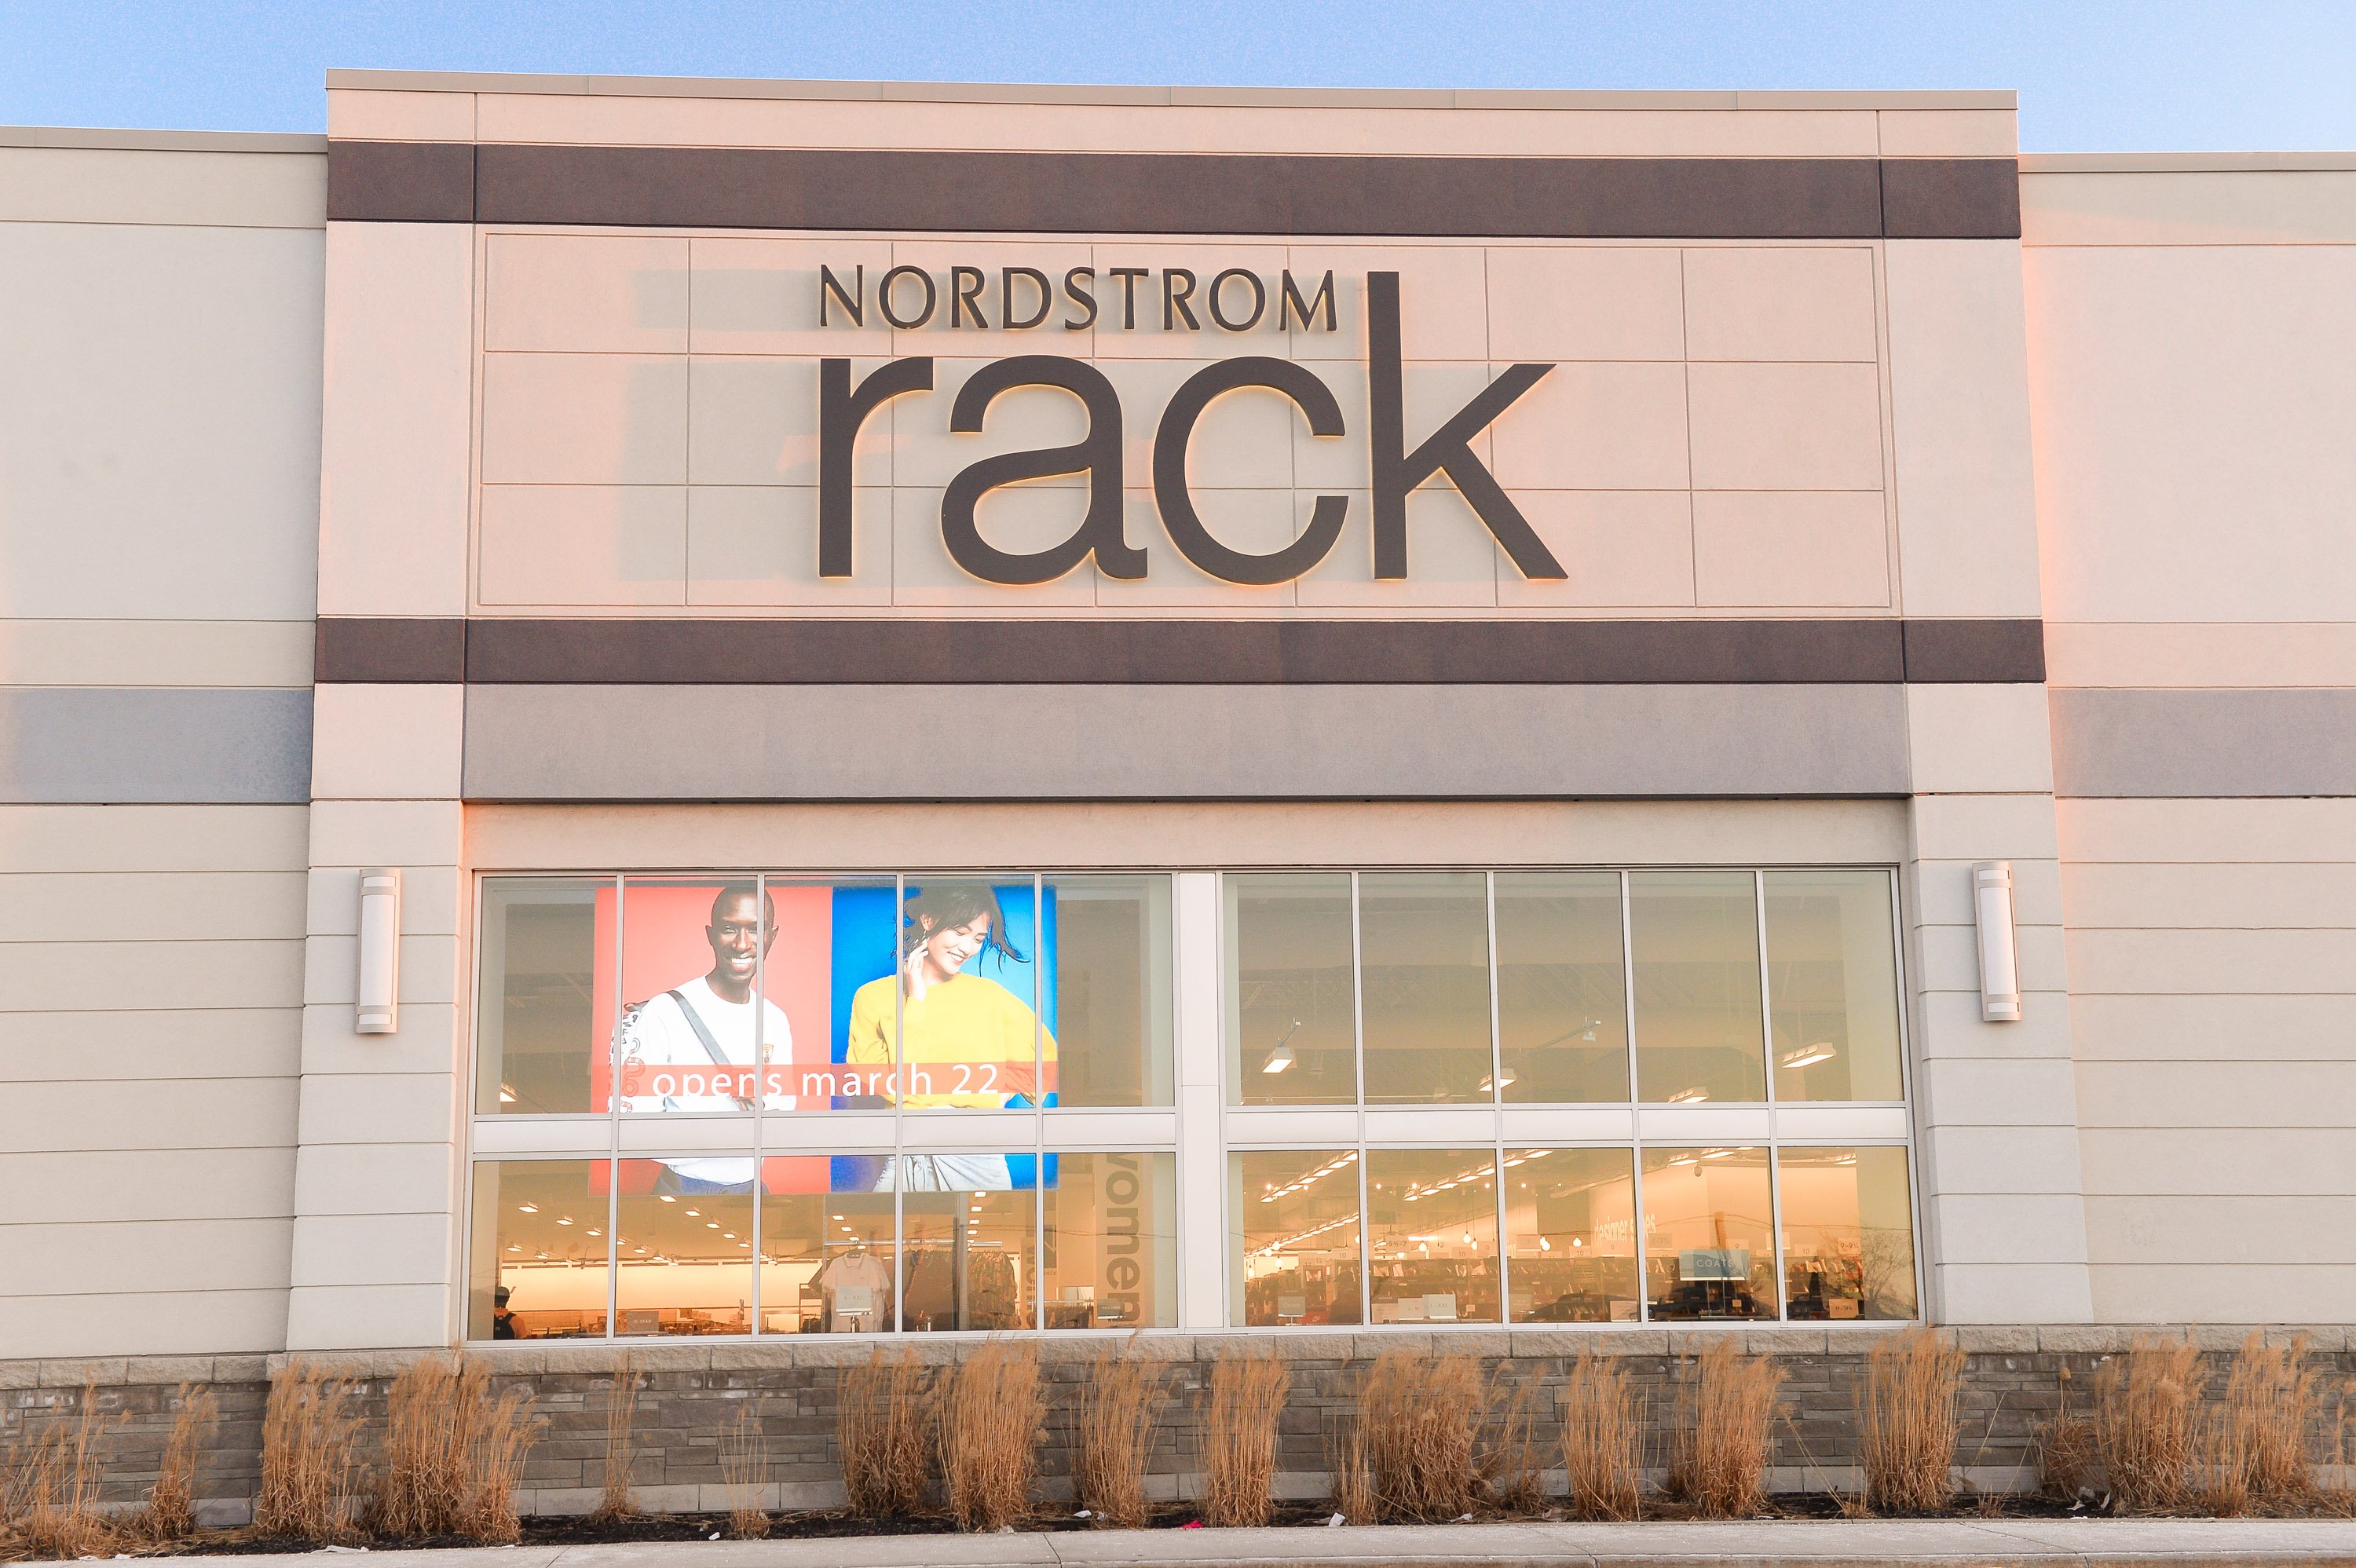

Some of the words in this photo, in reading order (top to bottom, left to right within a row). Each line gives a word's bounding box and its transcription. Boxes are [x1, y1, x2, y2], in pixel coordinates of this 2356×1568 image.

[821, 265, 1337, 331] NORDSTROM
[820, 271, 1568, 585] rack
[653, 1073, 783, 1098] opens
[951, 1063, 998, 1095] 22
[1696, 1259, 1735, 1268] COATS
